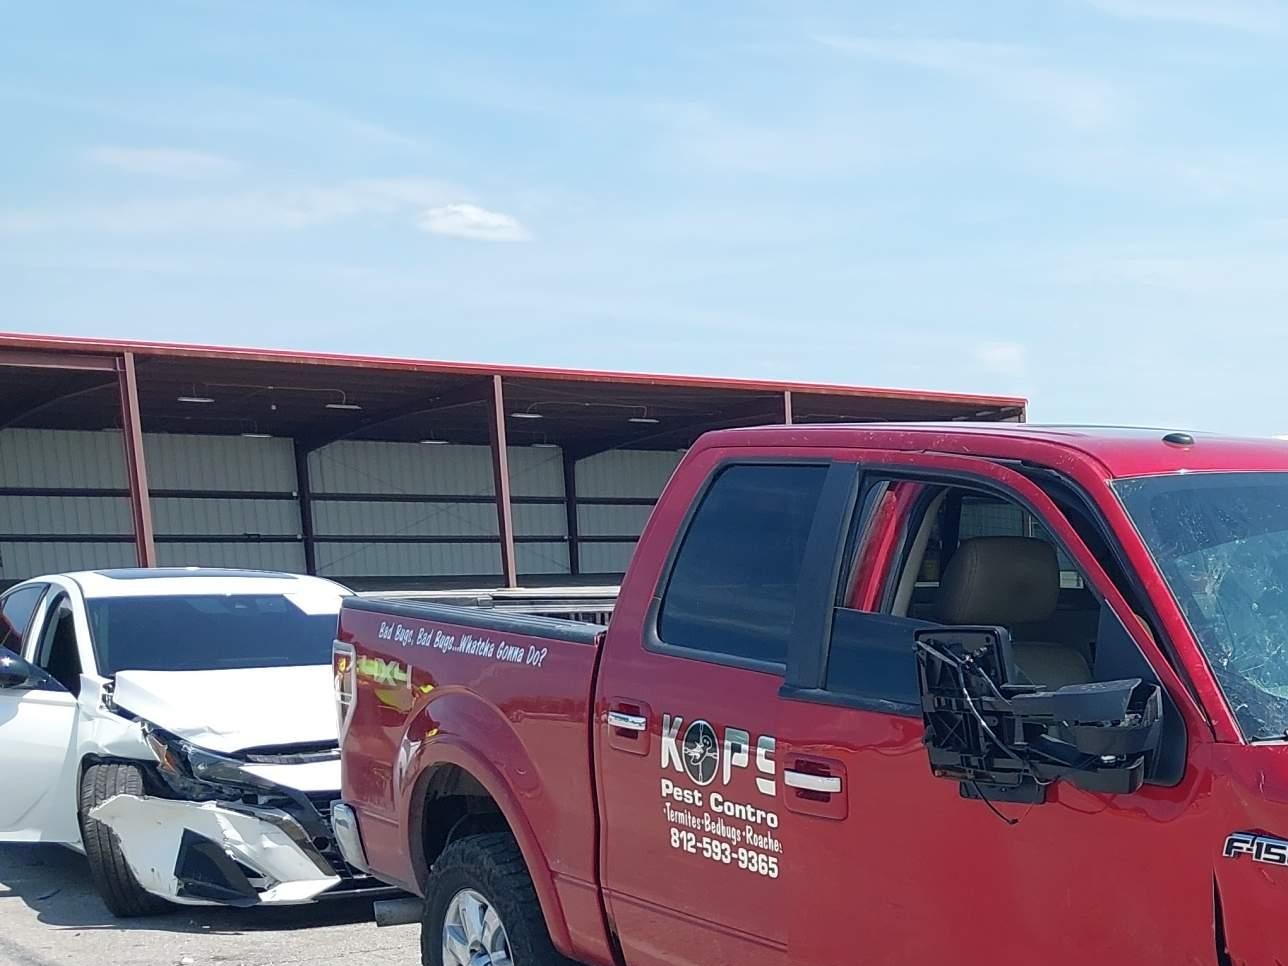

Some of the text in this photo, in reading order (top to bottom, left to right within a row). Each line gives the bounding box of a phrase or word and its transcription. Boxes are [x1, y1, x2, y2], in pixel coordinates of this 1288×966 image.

[379, 621, 395, 640] Bad
[395, 624, 414, 647] Bugs,
[416, 628, 434, 647] Bad
[496, 641, 524, 663] Gonna
[526, 645, 548, 667] Do?
[660, 778, 703, 807] Pest
[670, 827, 780, 879] 812-593-9365
